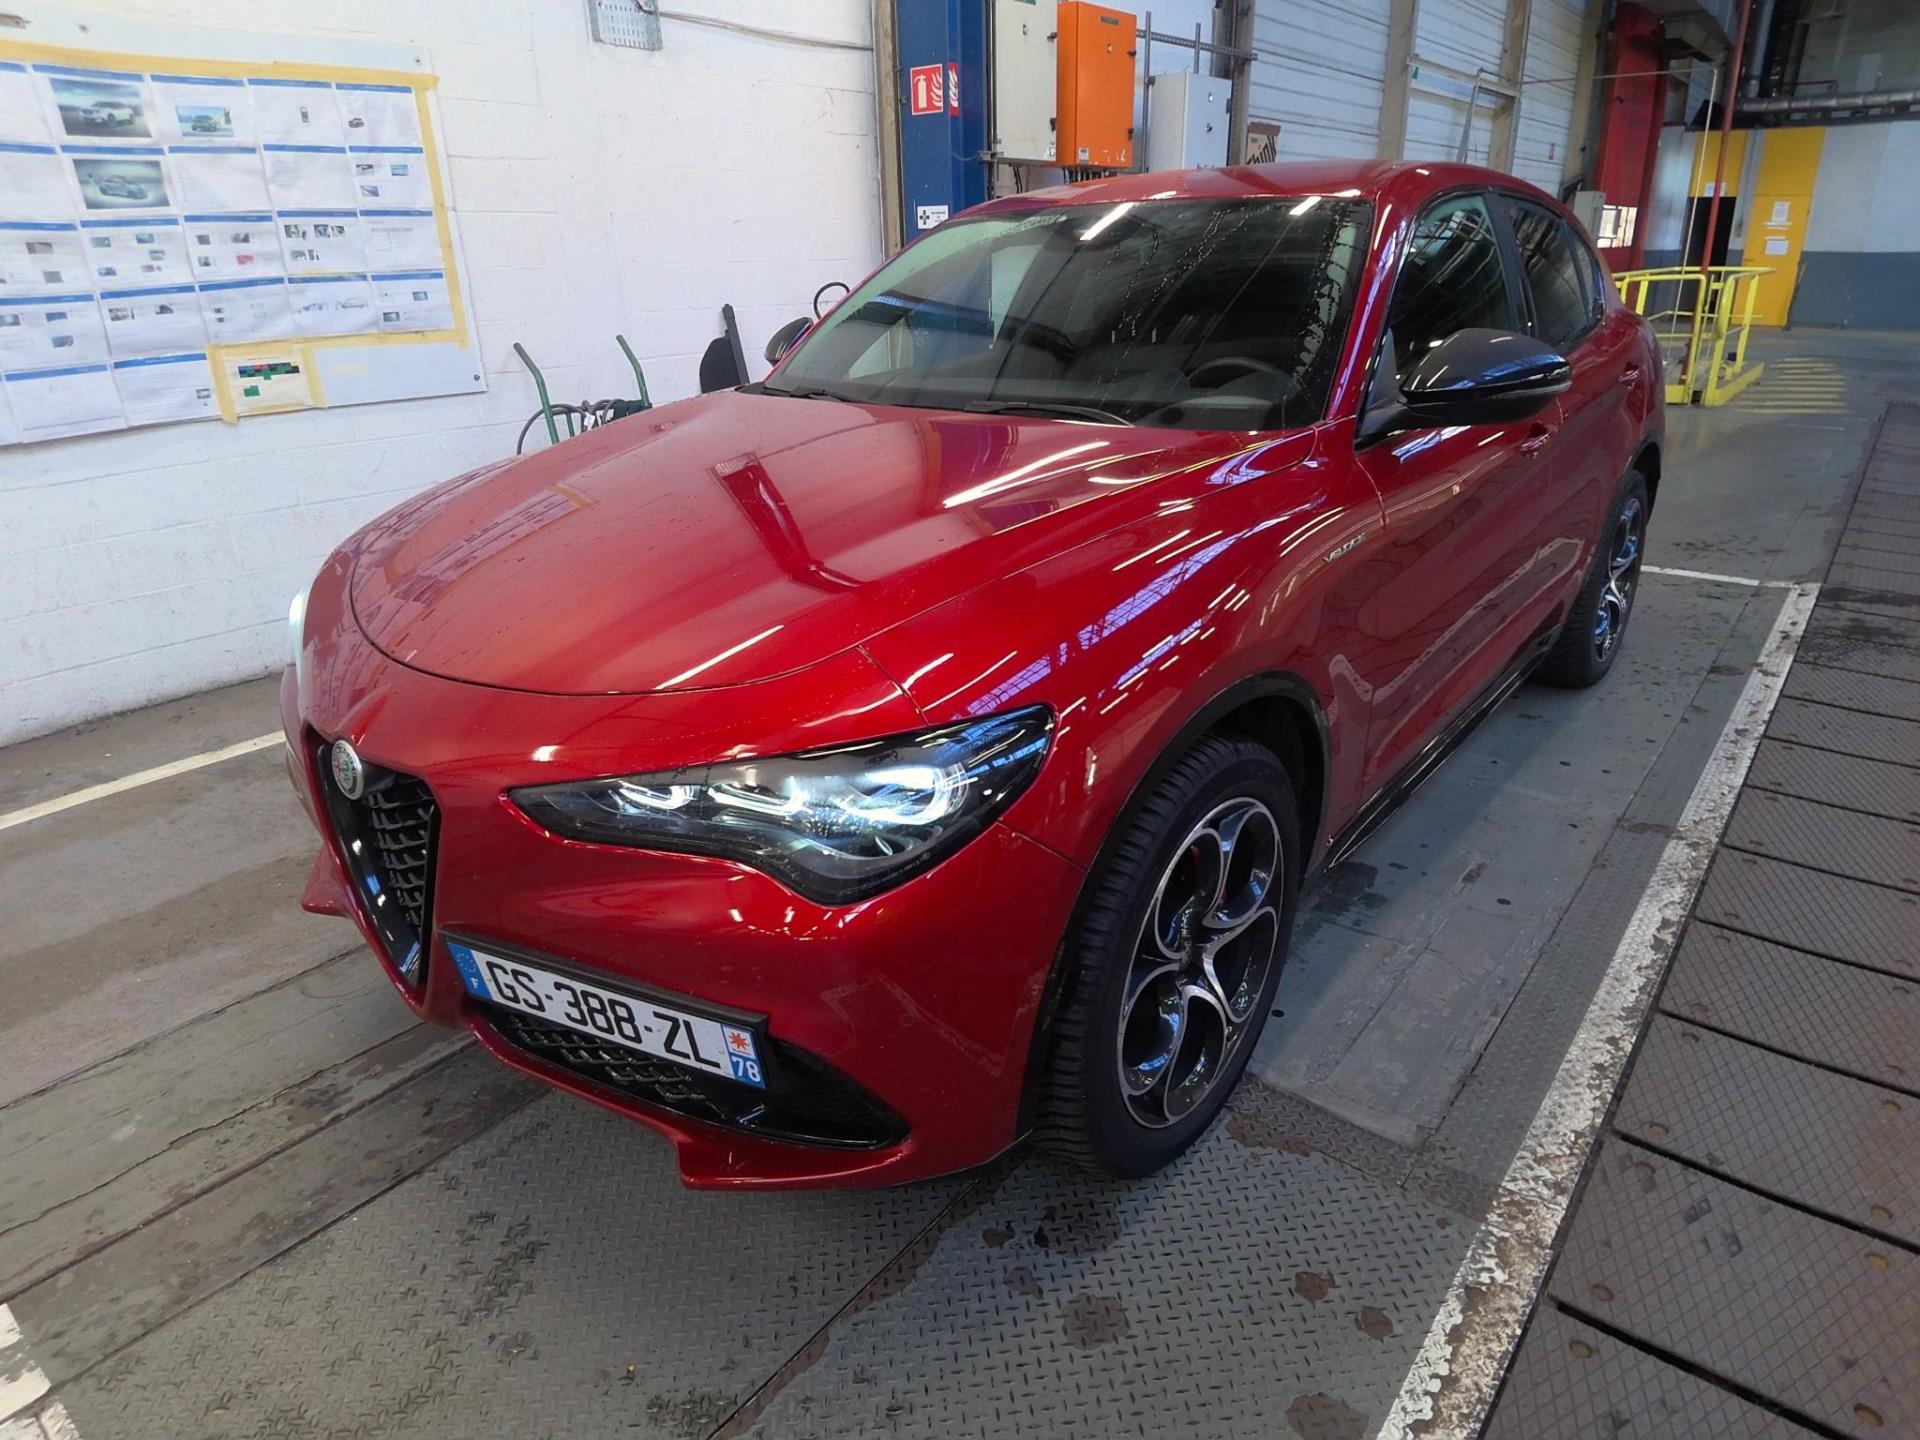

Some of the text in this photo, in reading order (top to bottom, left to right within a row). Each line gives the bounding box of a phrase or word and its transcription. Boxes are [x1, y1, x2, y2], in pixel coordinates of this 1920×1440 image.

[471, 976, 480, 989] F
[486, 961, 721, 1069] GS-388-ZL
[731, 1055, 760, 1082] 78
